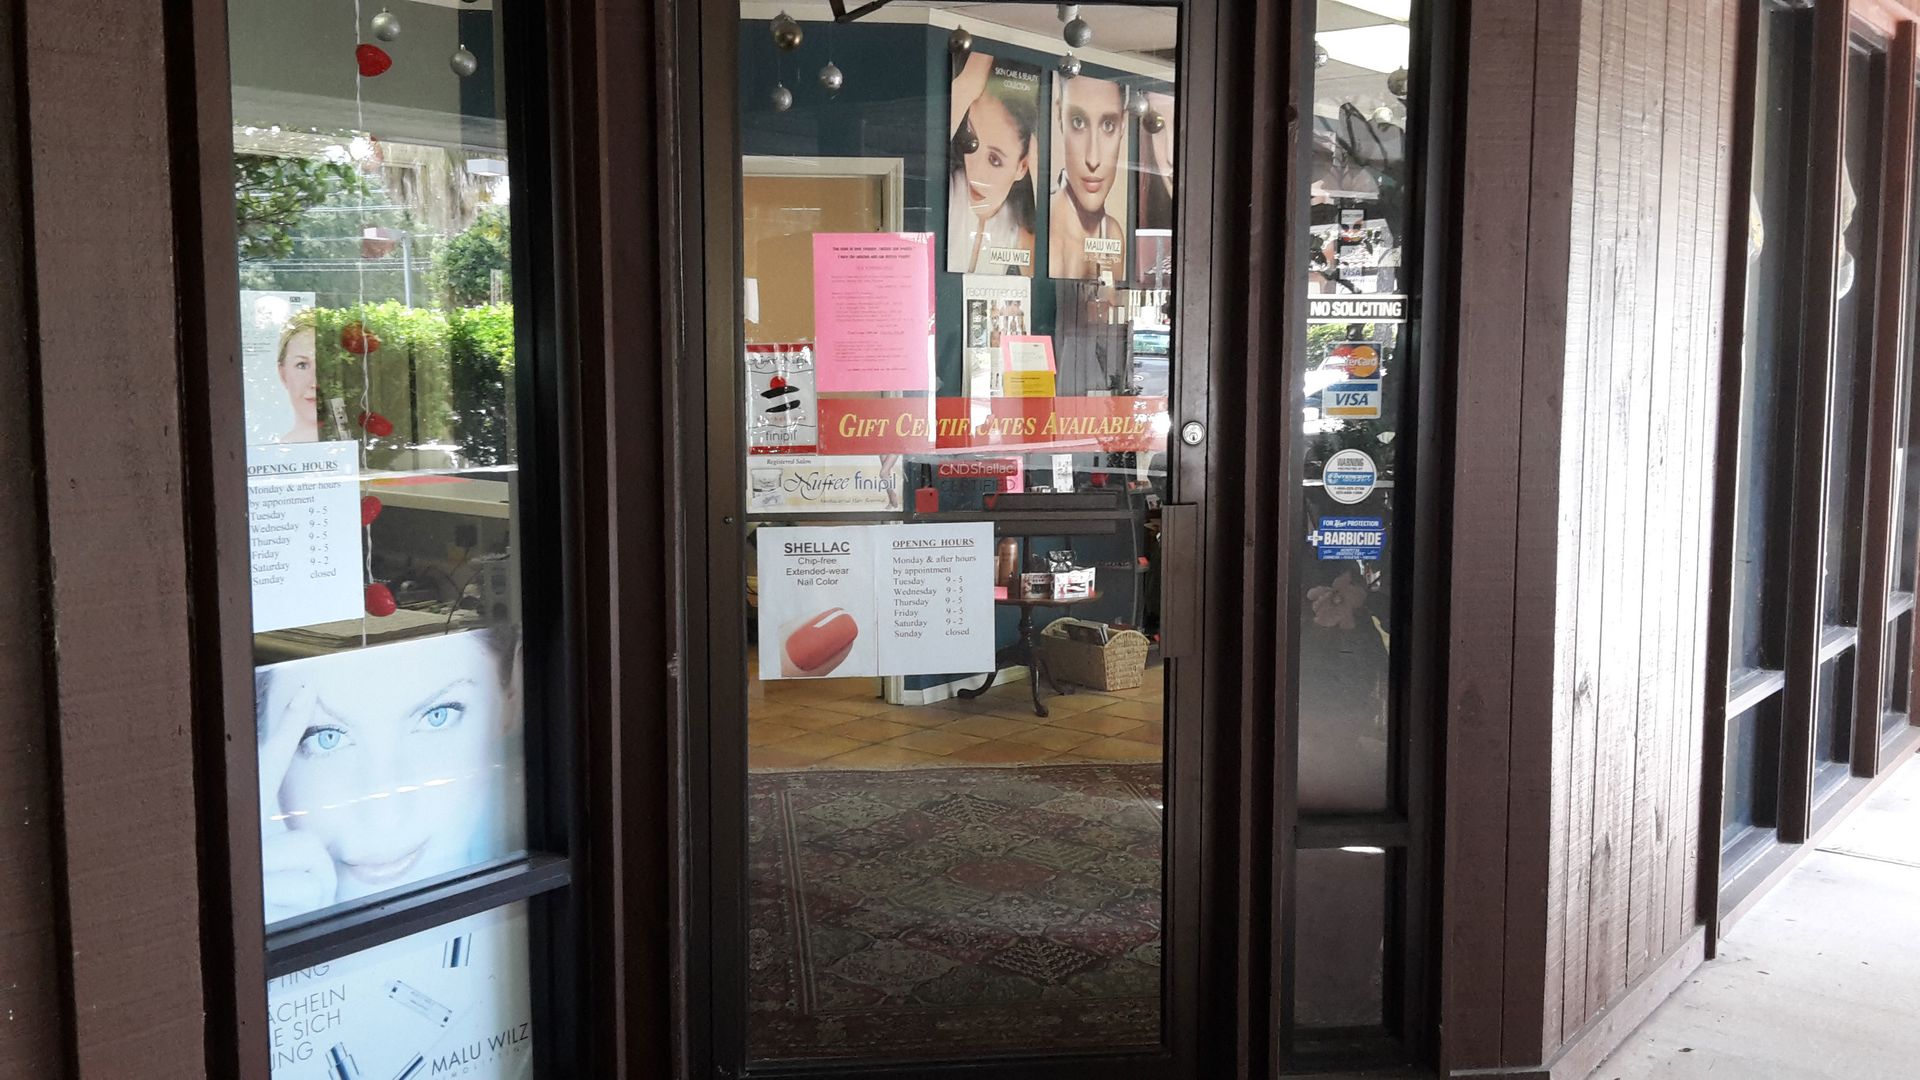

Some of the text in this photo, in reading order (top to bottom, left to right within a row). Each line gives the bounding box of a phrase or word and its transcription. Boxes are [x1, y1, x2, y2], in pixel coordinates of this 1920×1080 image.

[1086, 240, 1121, 252] MALU WILZ
[990, 250, 1030, 264] MALU WILZ
[1309, 301, 1402, 316] NO SOLICITING
[1336, 393, 1369, 406] VISA
[839, 413, 890, 438] GIFT
[1041, 412, 1146, 436] AVAILABLE
[248, 460, 339, 475] OPENING HOURS
[766, 458, 795, 467] Registered
[249, 480, 342, 495] Monday & after hours
[783, 470, 896, 500] Nufree finipil
[250, 496, 315, 510] by appointment
[250, 511, 286, 521] Tuesday
[308, 507, 314, 515] 9
[323, 506, 328, 515] 5
[250, 522, 299, 533] Wednesday
[309, 519, 315, 527] 9
[323, 518, 328, 527] 5
[251, 535, 291, 547] Thursday
[308, 532, 315, 540] 9
[323, 531, 328, 540] 5
[892, 538, 975, 548] OPENING HOURS
[1323, 531, 1382, 546] BARBICIDE
[784, 541, 850, 554] SHELLAC
[252, 549, 280, 560] Friday
[798, 556, 837, 566] Chip-free
[892, 554, 977, 565] Monday & after hours
[252, 561, 290, 573] Saturday
[310, 557, 316, 565] 9
[323, 556, 329, 565] 2
[893, 566, 952, 576] by appointment
[252, 568, 337, 585] Sunday closed
[786, 567, 849, 576] Extended-wear
[815, 577, 839, 586] Color
[893, 577, 925, 587] Tuesday
[945, 576, 951, 584] 9
[959, 576, 963, 584] 5
[893, 588, 937, 596] Wednesday
[946, 586, 952, 594] 9
[959, 586, 964, 594] 5
[893, 598, 929, 607] Thursday
[945, 597, 951, 605] 9
[958, 596, 963, 604] 5
[894, 609, 919, 618] Friday
[946, 607, 952, 615] 9
[959, 607, 964, 615] 5
[894, 619, 928, 628] Saturday
[945, 617, 951, 625] 9
[958, 617, 964, 625] 2
[894, 628, 970, 639] Sunday closed
[293, 1008, 341, 1041] SICH
[431, 1041, 481, 1076] MALU
[487, 1022, 529, 1052] WILZ
